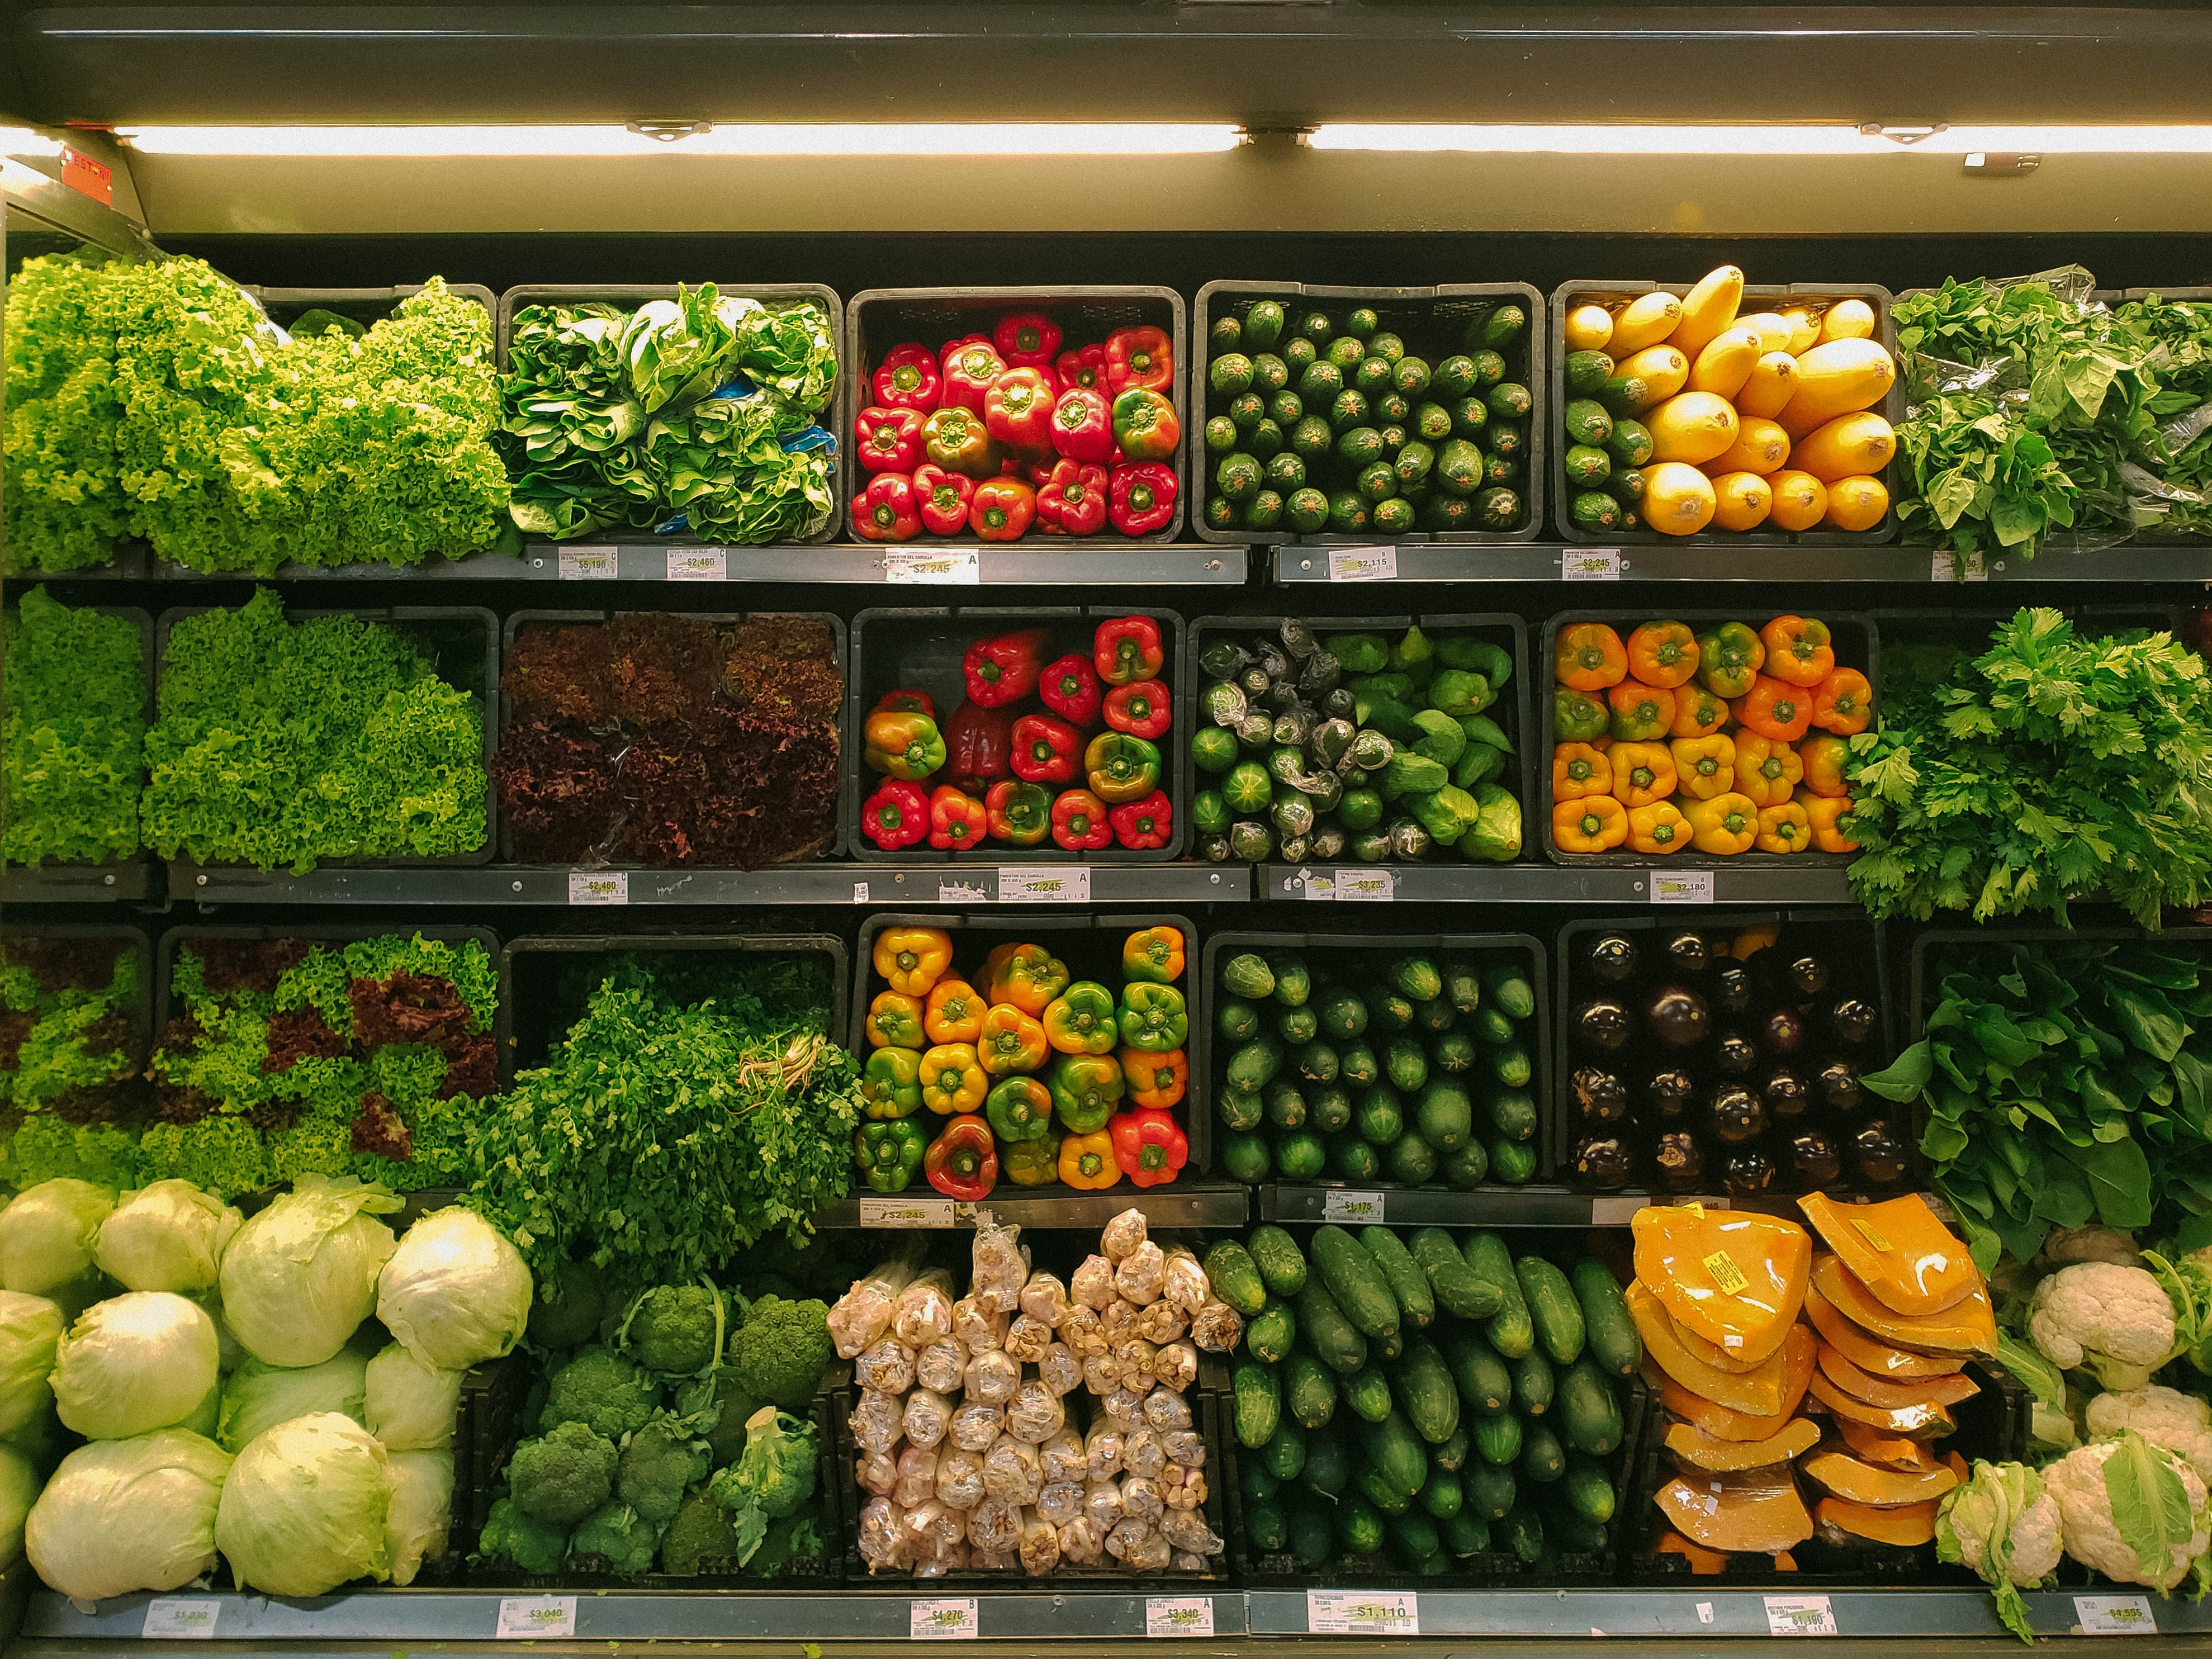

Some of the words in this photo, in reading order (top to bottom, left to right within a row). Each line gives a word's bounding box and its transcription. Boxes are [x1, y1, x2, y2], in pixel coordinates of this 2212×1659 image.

[720, 549, 724, 558] C
[687, 558, 714, 567] $2,460
[968, 555, 977, 564] A
[1357, 558, 1387, 567] $2,115
[1583, 559, 1610, 567] $2,245
[579, 560, 606, 570] $5,190
[1079, 873, 1087, 882] A
[589, 881, 616, 890] $2,460
[1026, 883, 1061, 893] $2,245
[1358, 880, 1385, 890] $3,235
[1377, 1195, 1382, 1203] A
[969, 1599, 974, 1609] B
[1204, 1599, 1210, 1608] A
[1398, 1598, 1404, 1606] A
[529, 1609, 563, 1618] $3,040
[1167, 1609, 1198, 1619] $3,340
[1357, 1606, 1406, 1618] $1,110
[1826, 1605, 1833, 1614] A
[2110, 1609, 2143, 1617] $4,555
[1792, 1615, 1823, 1625] $1,190
